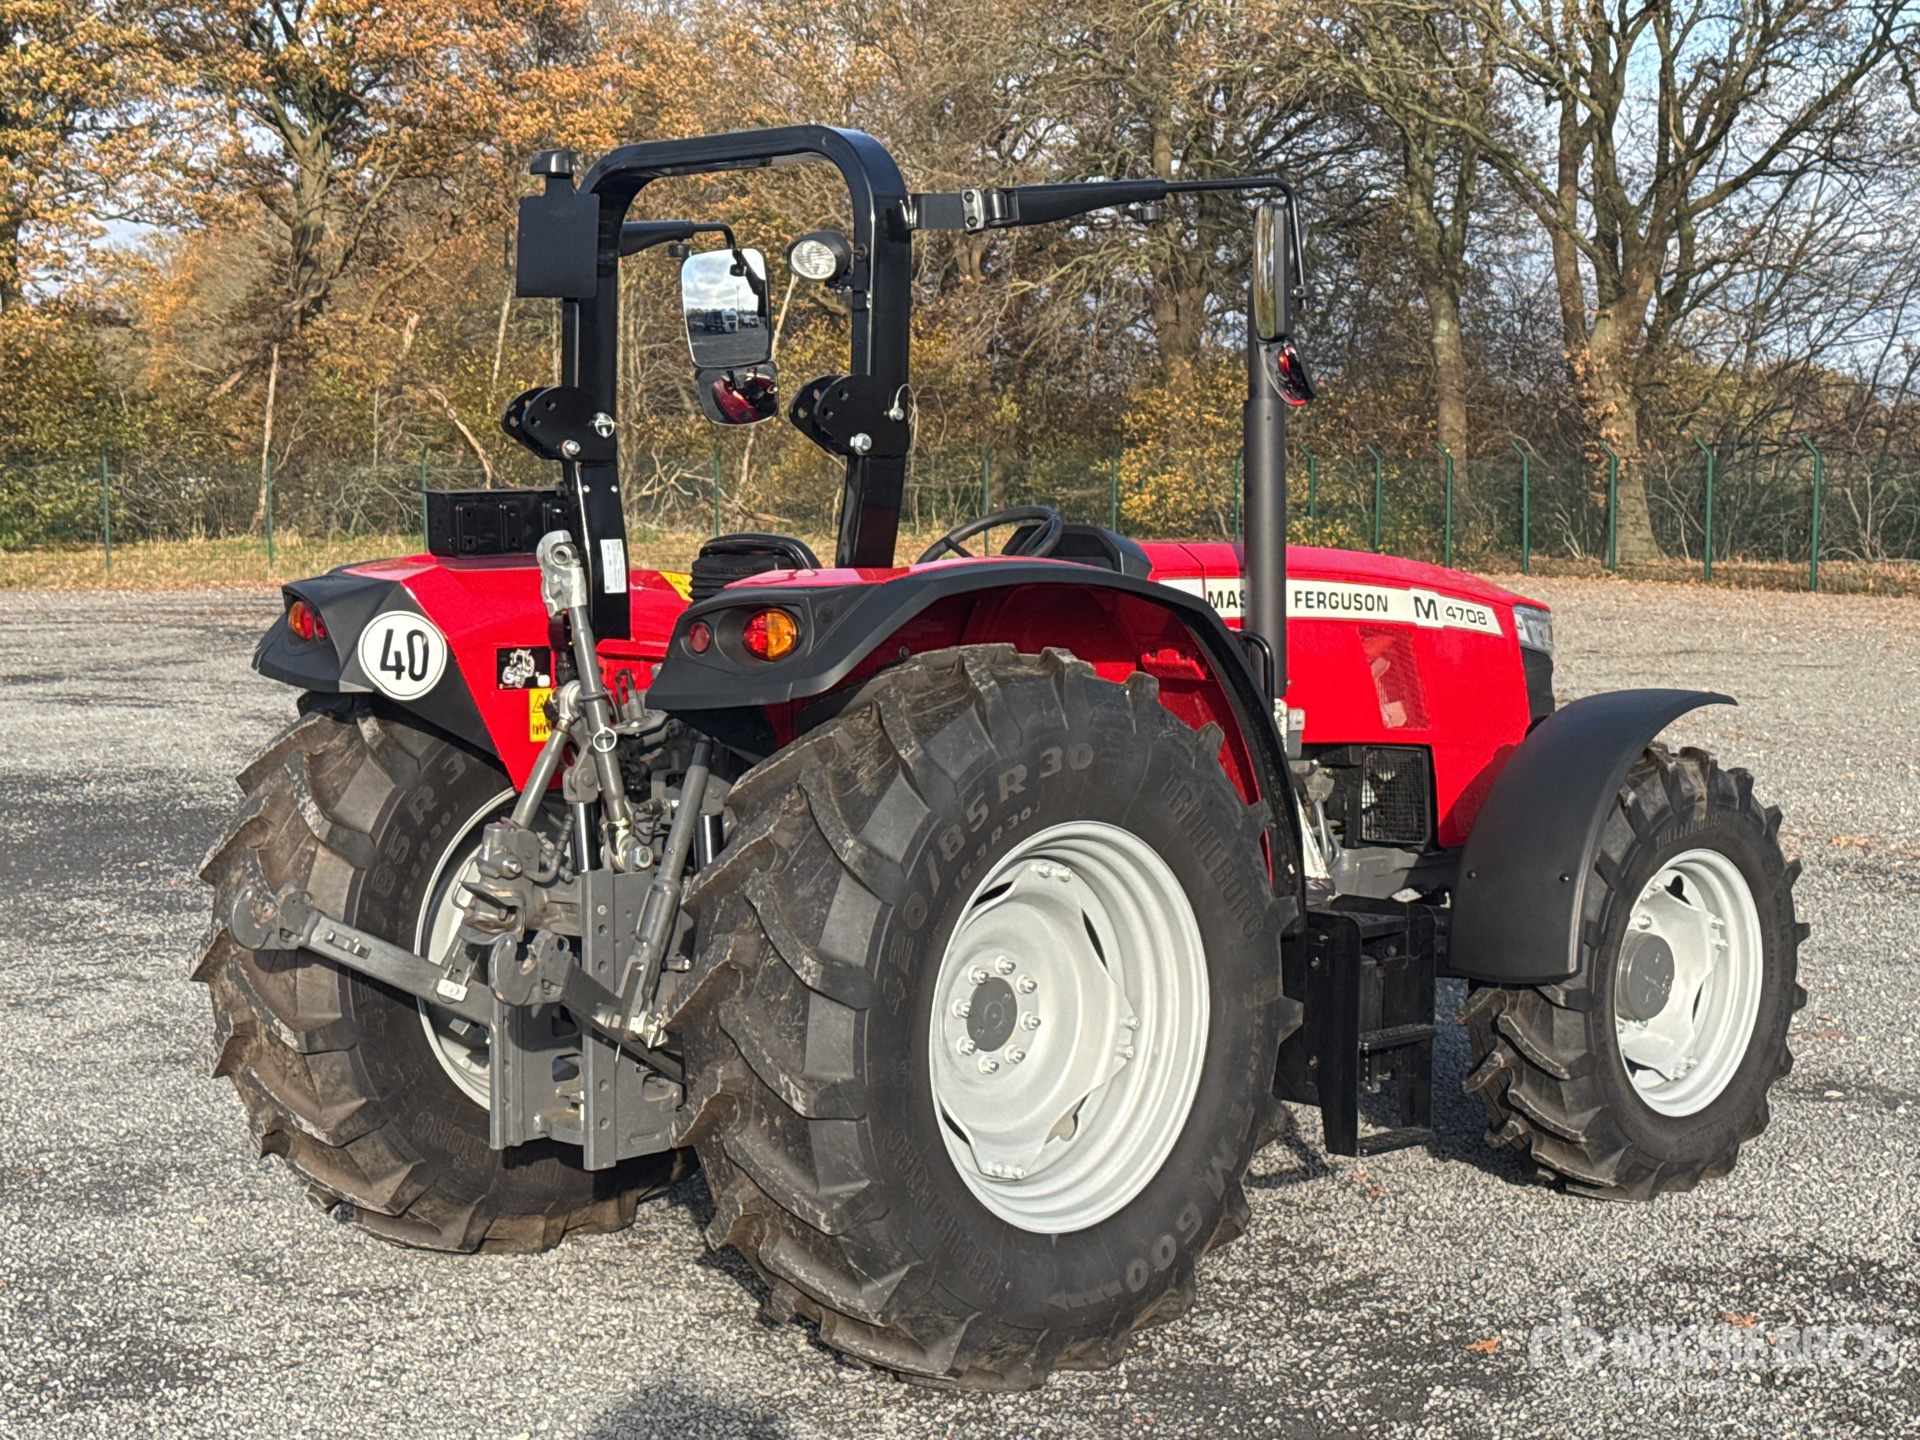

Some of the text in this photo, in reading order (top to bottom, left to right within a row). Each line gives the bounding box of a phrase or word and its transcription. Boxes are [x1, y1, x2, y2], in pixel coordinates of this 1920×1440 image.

[1207, 590, 1388, 612] MAS FERGUSON
[1413, 596, 1488, 626] M 4708
[380, 628, 430, 681] 40
[440, 751, 480, 788] 3
[998, 763, 1029, 805] R
[1038, 741, 1095, 780] 30
